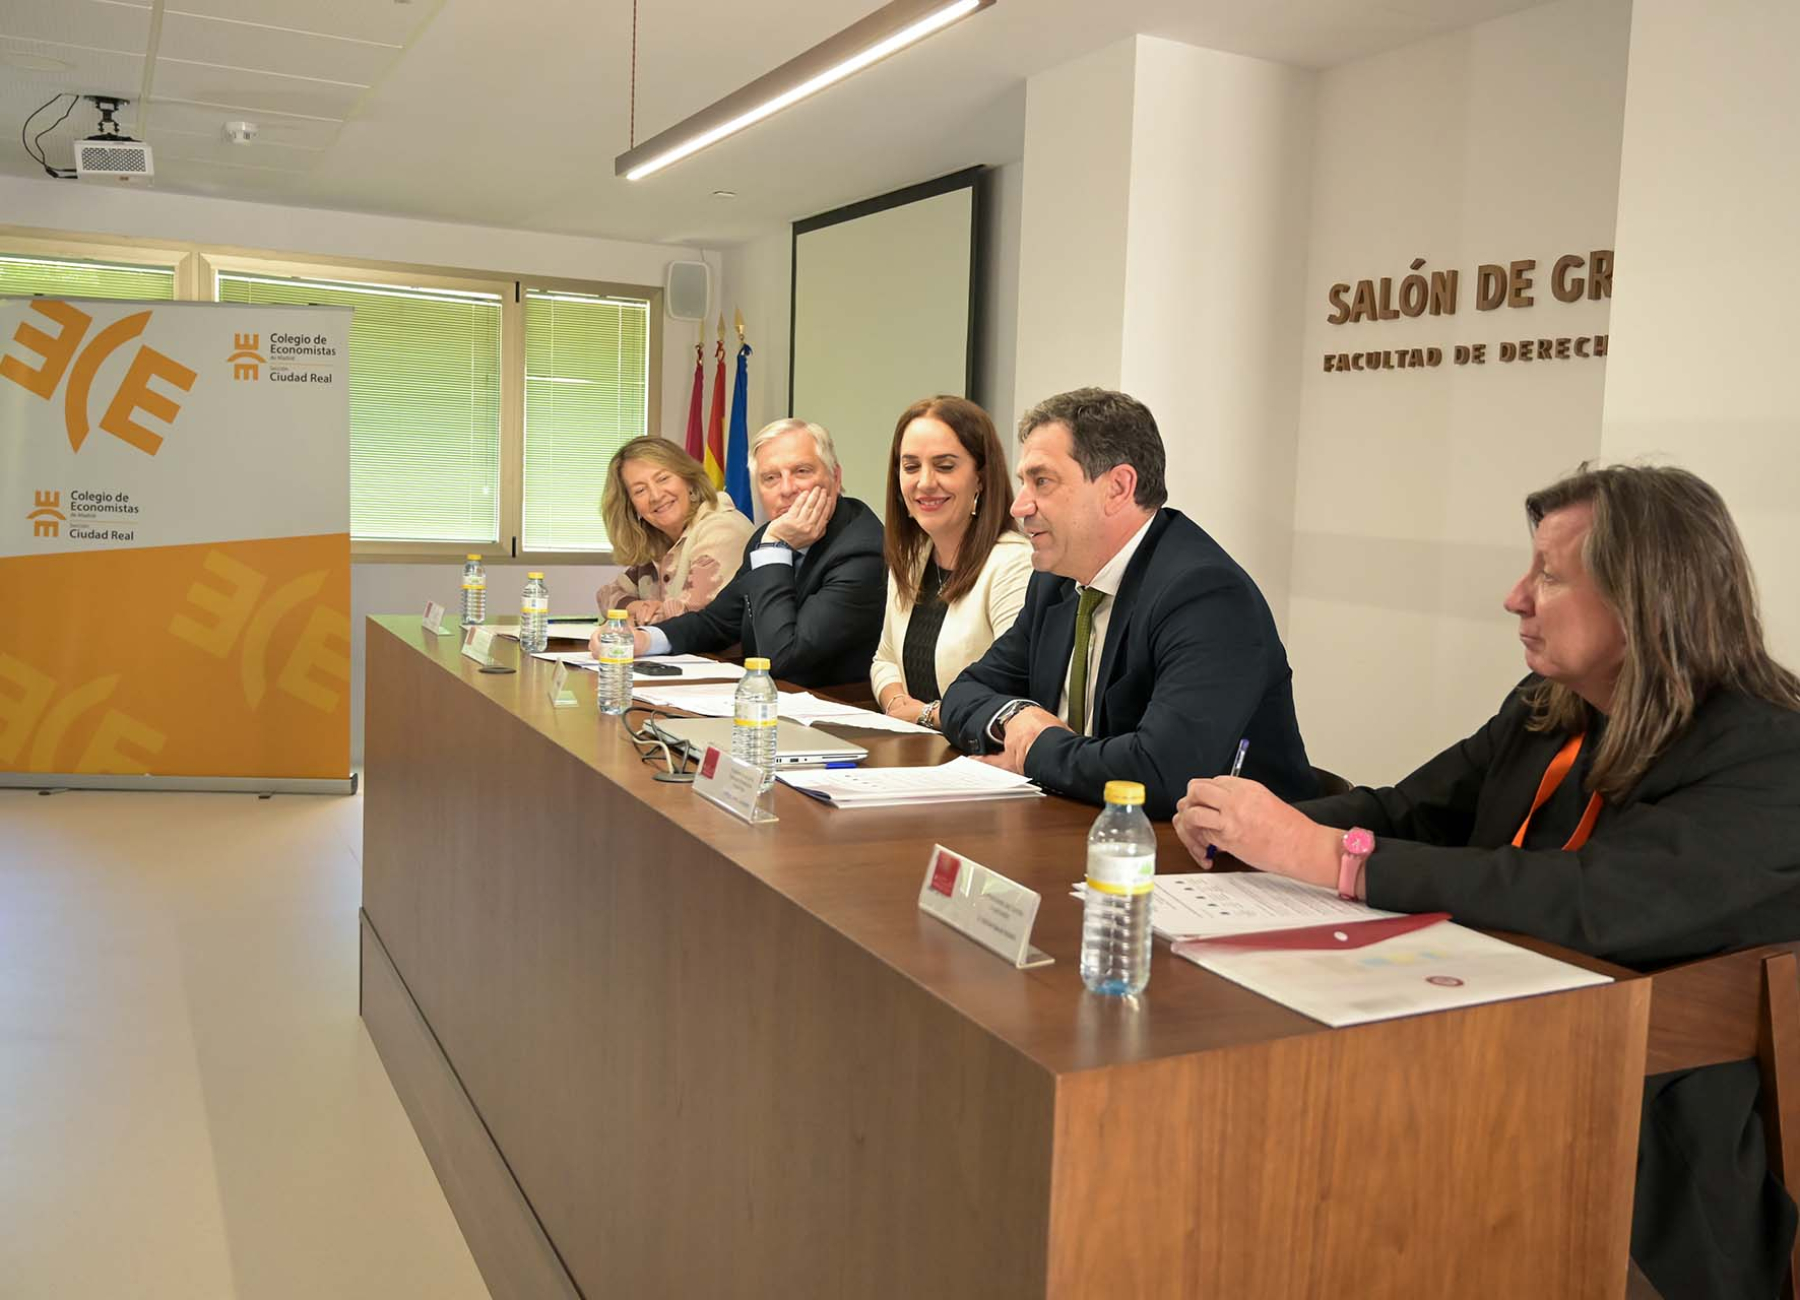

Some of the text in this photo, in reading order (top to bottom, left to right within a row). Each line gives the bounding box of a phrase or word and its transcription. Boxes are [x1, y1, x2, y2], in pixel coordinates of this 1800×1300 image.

[1327, 250, 1614, 325] SALÓN DE GR
[270, 333, 327, 346] Colegio de
[270, 344, 336, 356] Economistas
[1323, 335, 1609, 373] FACULTAD DE DERECH
[269, 372, 332, 383] Ciudad Real
[71, 490, 129, 503] Colegio de
[70, 502, 139, 514] Economistas
[69, 529, 134, 541] Ciudad Real
